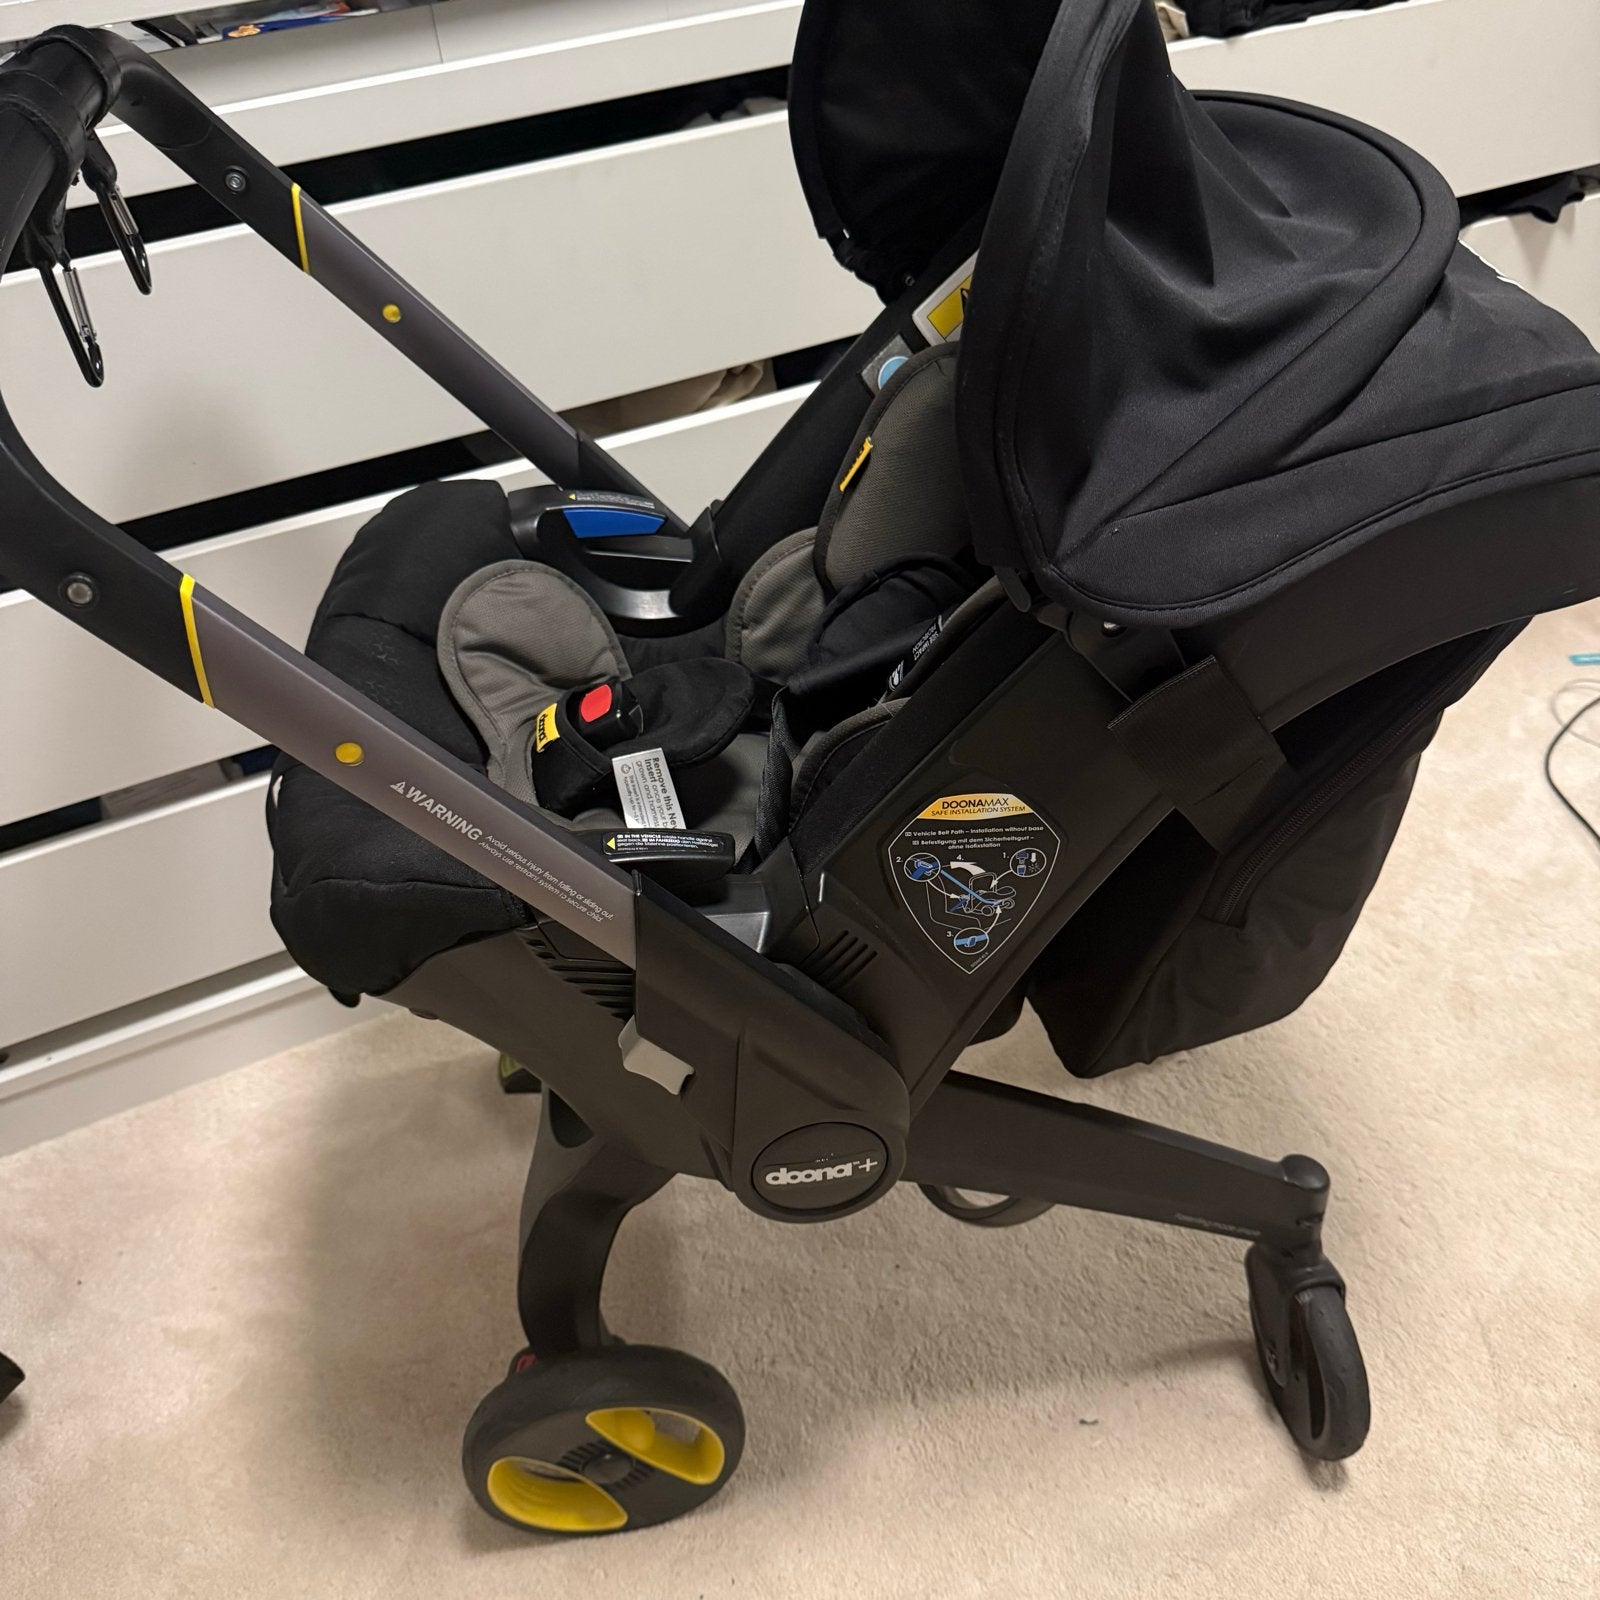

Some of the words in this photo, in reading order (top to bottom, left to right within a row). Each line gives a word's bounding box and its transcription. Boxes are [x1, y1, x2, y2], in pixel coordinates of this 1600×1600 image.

[636, 760, 648, 783] grown
[644, 784, 653, 800] and
[645, 758, 658, 782] Insert
[652, 757, 668, 794] Remove
[663, 796, 674, 811] this
[652, 784, 662, 804] once
[406, 786, 483, 840] WARNING
[656, 805, 667, 821] your
[941, 797, 1009, 810] DOONAMAX
[949, 807, 999, 815] INSTALLATION
[921, 838, 957, 846] Befestigung
[478, 841, 503, 858] Always
[502, 855, 515, 866] use
[537, 879, 560, 895] system
[566, 897, 587, 913] secure
[485, 835, 508, 850] Avoid
[505, 847, 528, 864] serious
[526, 860, 544, 875] injury
[542, 871, 559, 884] from
[557, 880, 577, 896] falling
[582, 898, 602, 913] sliding
